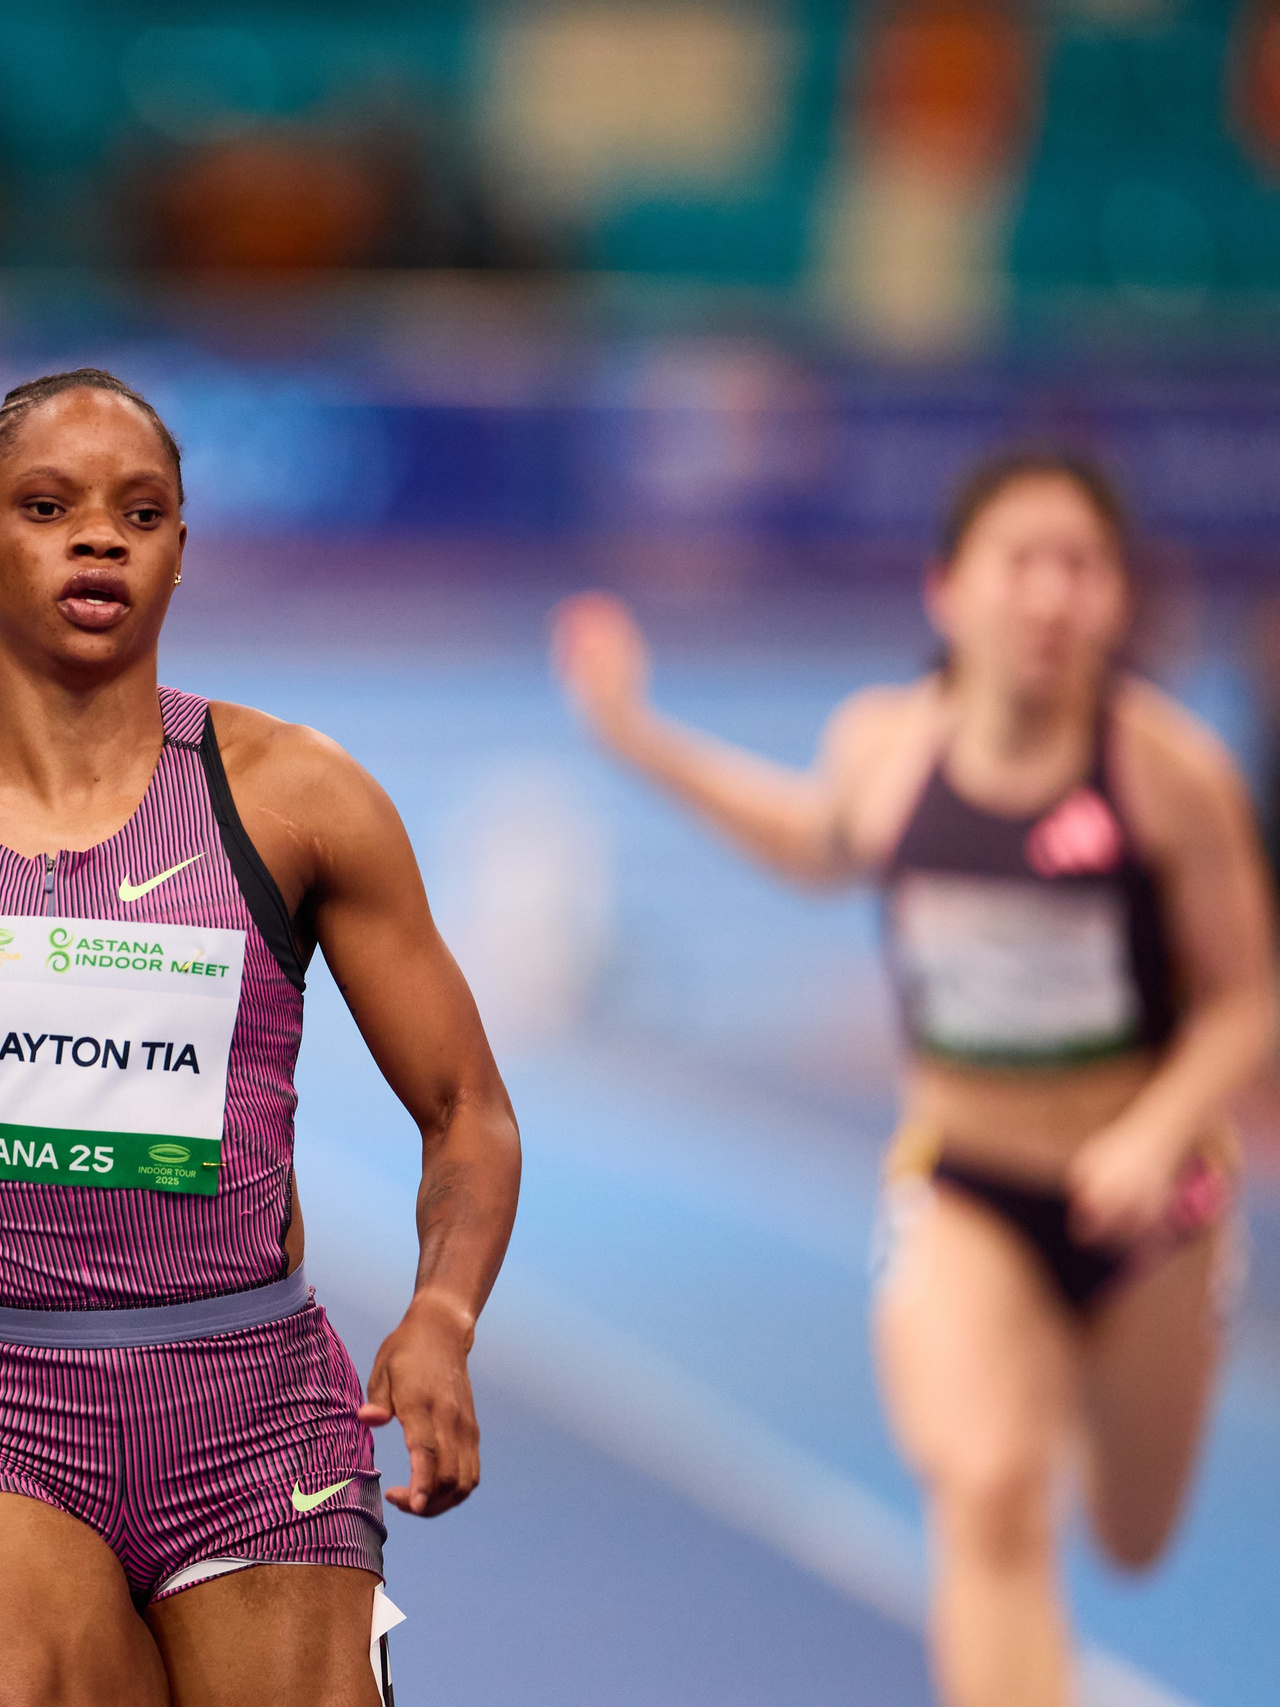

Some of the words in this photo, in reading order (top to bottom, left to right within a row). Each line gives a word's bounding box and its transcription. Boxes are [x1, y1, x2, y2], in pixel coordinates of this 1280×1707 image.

[76, 938, 164, 955] ASTANA
[75, 954, 162, 972] INDOOR
[170, 960, 229, 978] MEET
[141, 1041, 200, 1074] TIA
[69, 1144, 114, 1173] 25
[138, 1166, 172, 1176] INDOOR
[174, 1168, 196, 1178] TOUR
[155, 1175, 180, 1186] 2025
